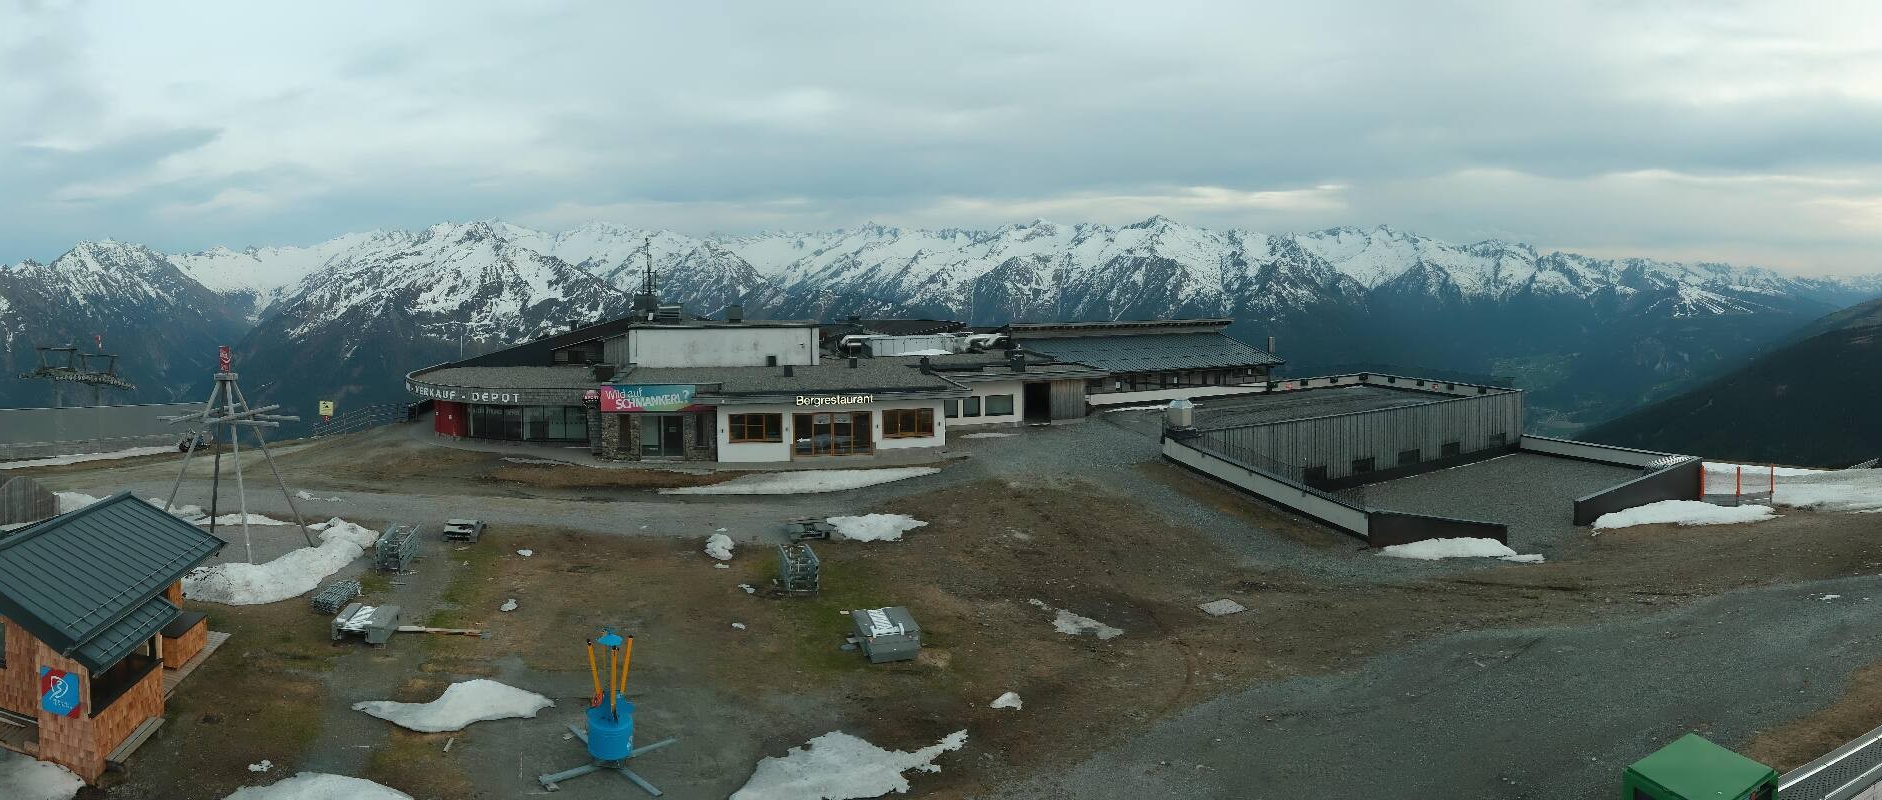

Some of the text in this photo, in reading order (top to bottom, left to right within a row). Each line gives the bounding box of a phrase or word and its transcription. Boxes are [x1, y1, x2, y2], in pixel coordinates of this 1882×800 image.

[415, 385, 456, 400] VERKAUF
[472, 392, 520, 403] DEPOT
[605, 388, 643, 400] Wild auf
[796, 394, 874, 408] Bergrestaurant
